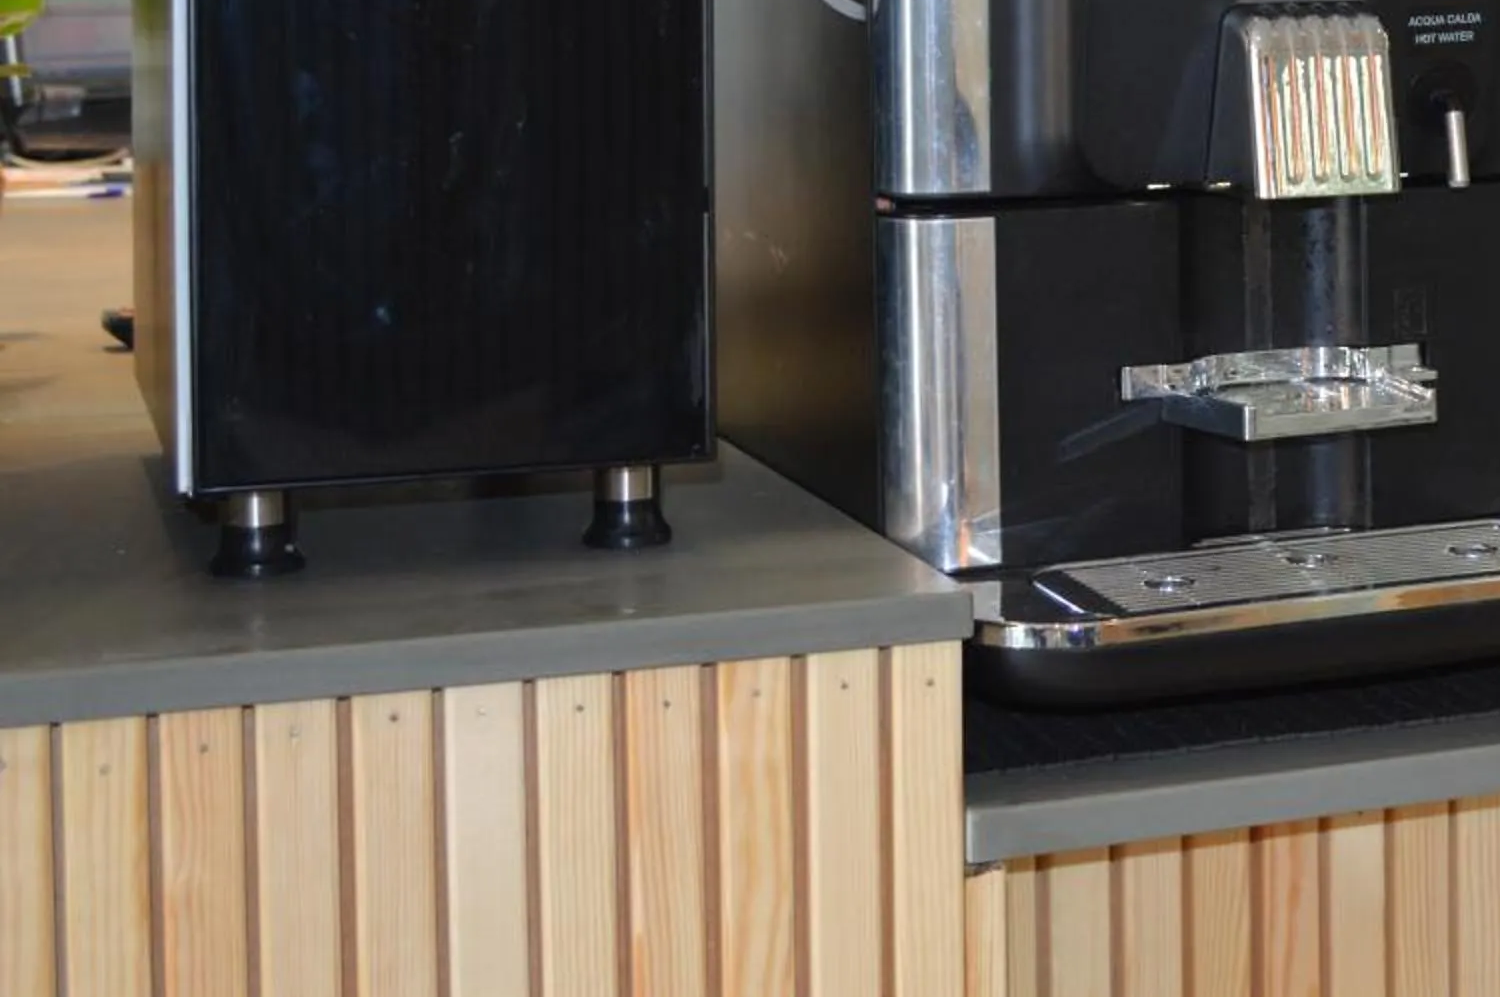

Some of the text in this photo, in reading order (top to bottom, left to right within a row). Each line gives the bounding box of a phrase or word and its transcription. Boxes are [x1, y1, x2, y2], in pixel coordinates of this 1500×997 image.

[1408, 12, 1482, 27] ACQUA CALDA
[1415, 30, 1474, 44] HOT WATER
